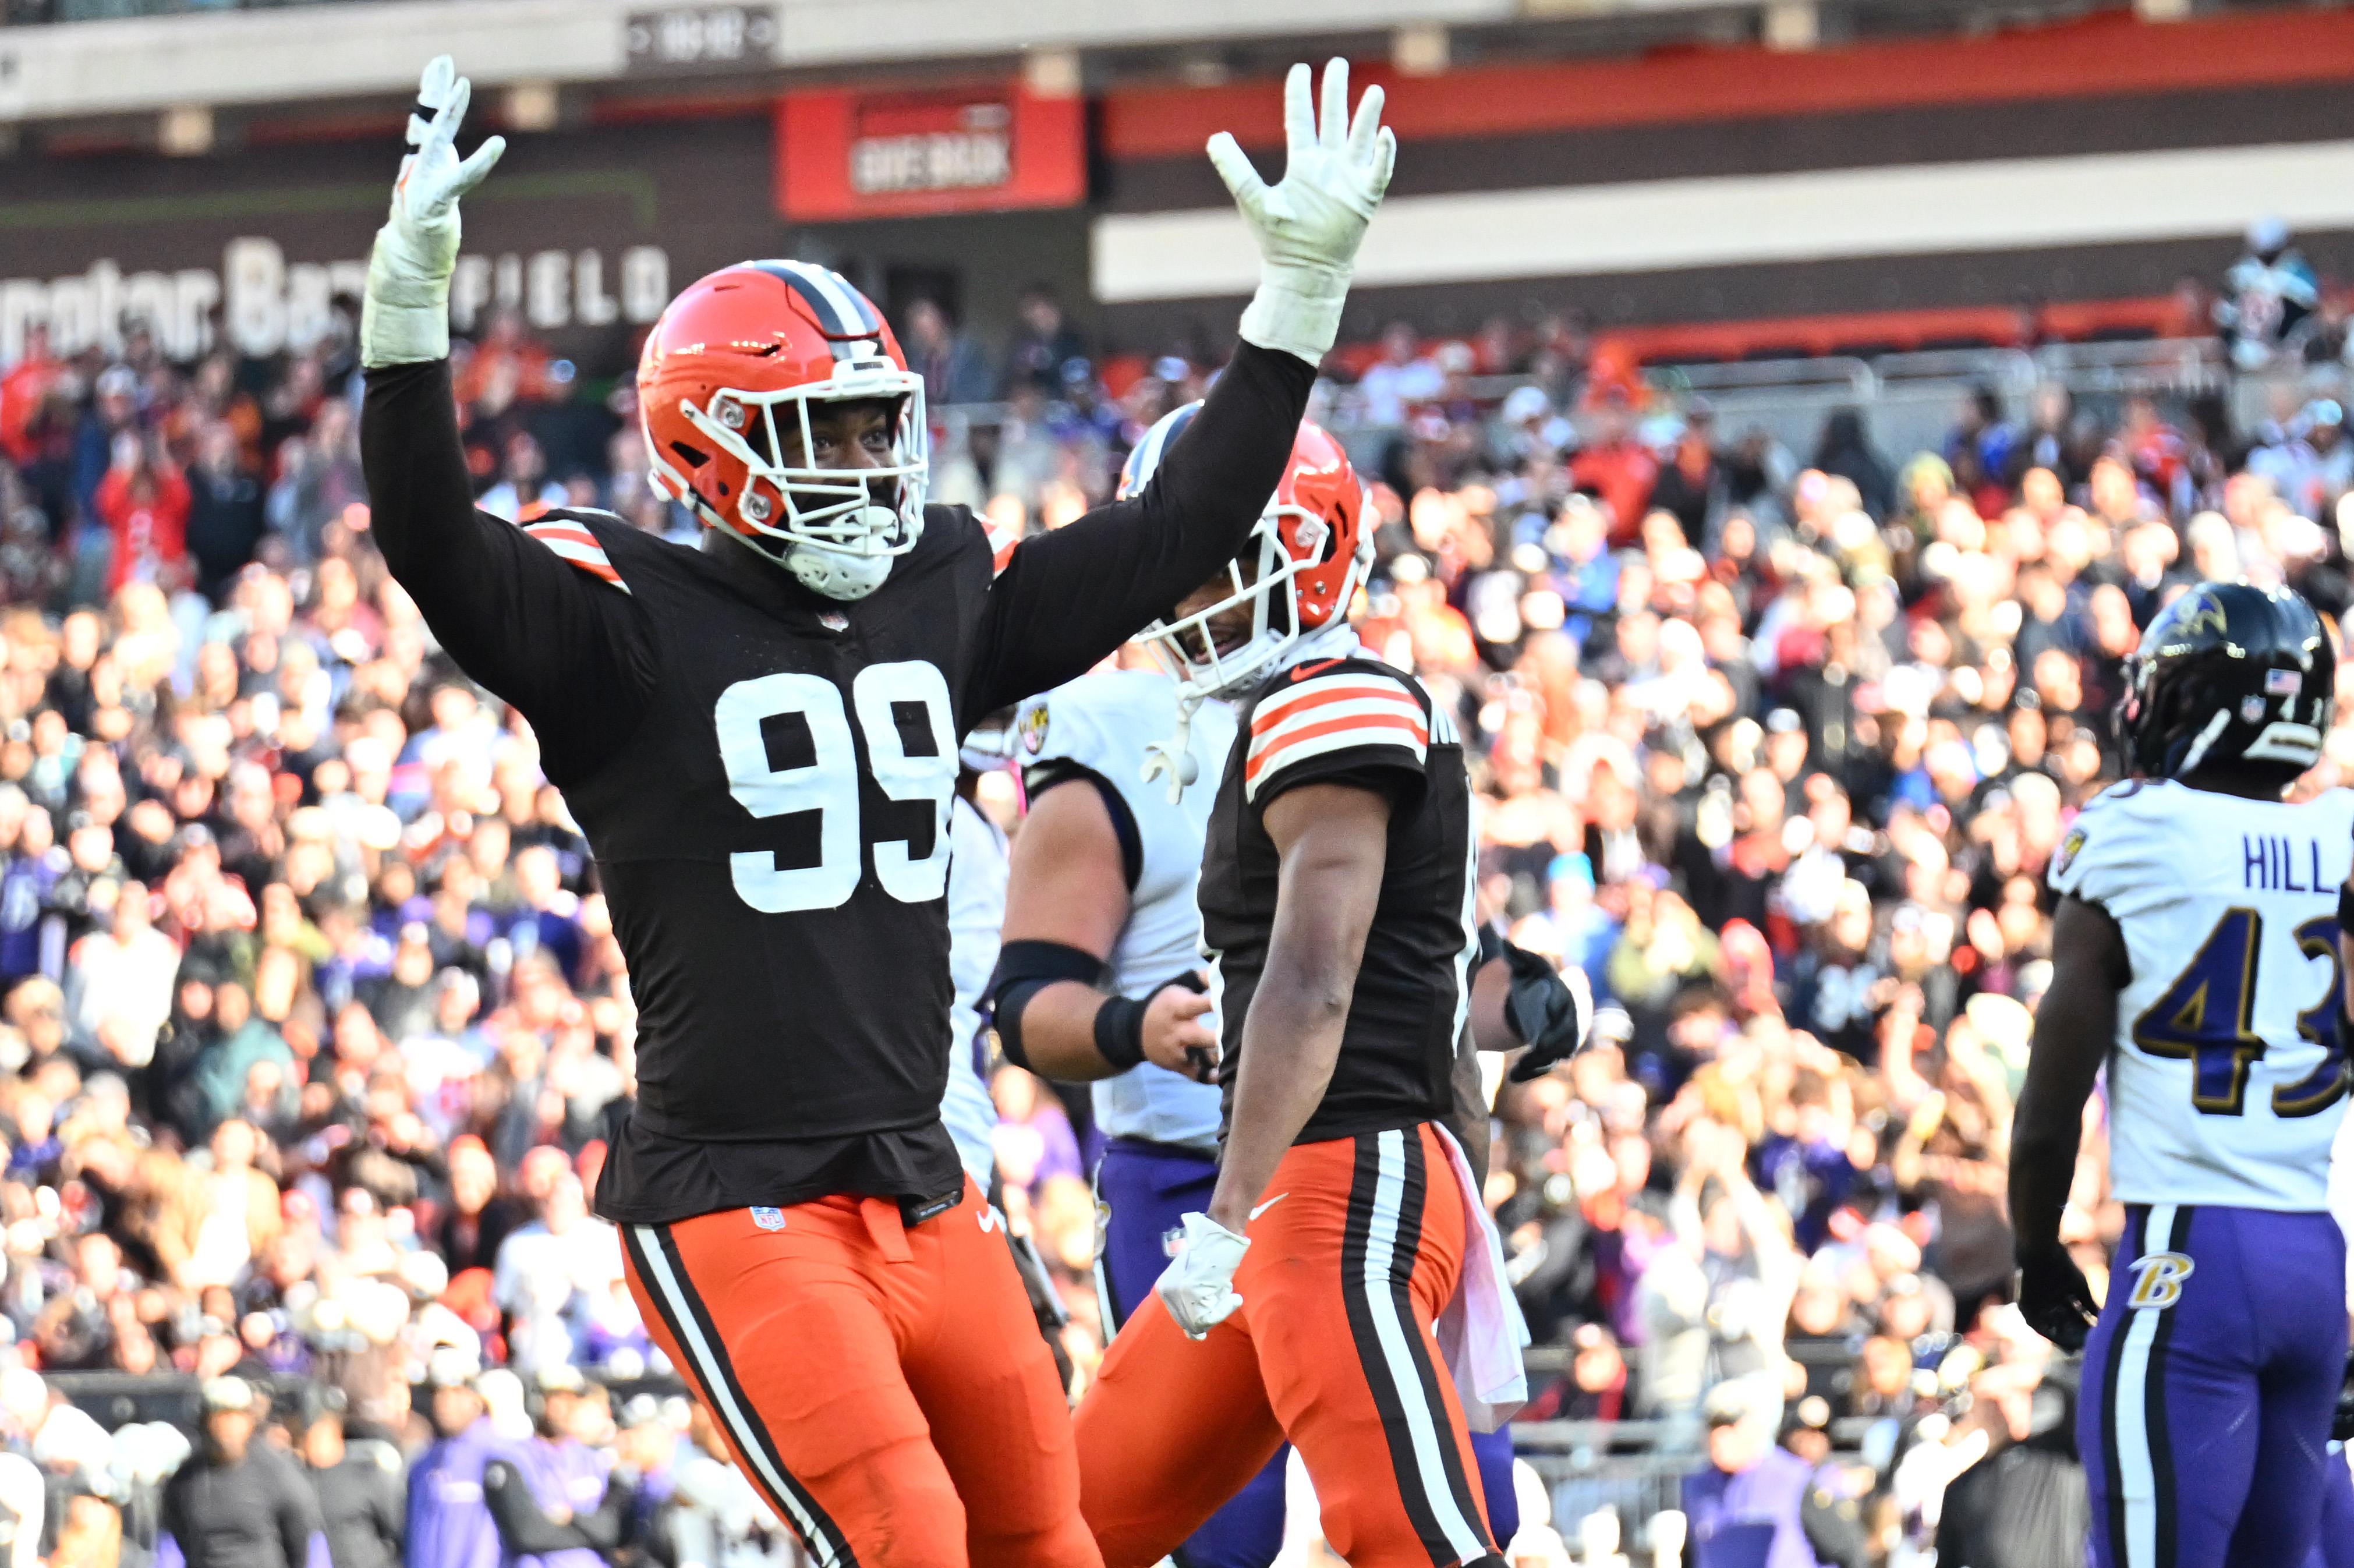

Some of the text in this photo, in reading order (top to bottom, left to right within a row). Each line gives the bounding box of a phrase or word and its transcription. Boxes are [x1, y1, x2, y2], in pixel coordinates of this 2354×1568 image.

[451, 245, 670, 328] FIELD
[714, 660, 960, 913] 99
[2243, 835, 2336, 893] HILL
[2132, 904, 2351, 1117] 43
[2127, 1251, 2194, 1309] B
